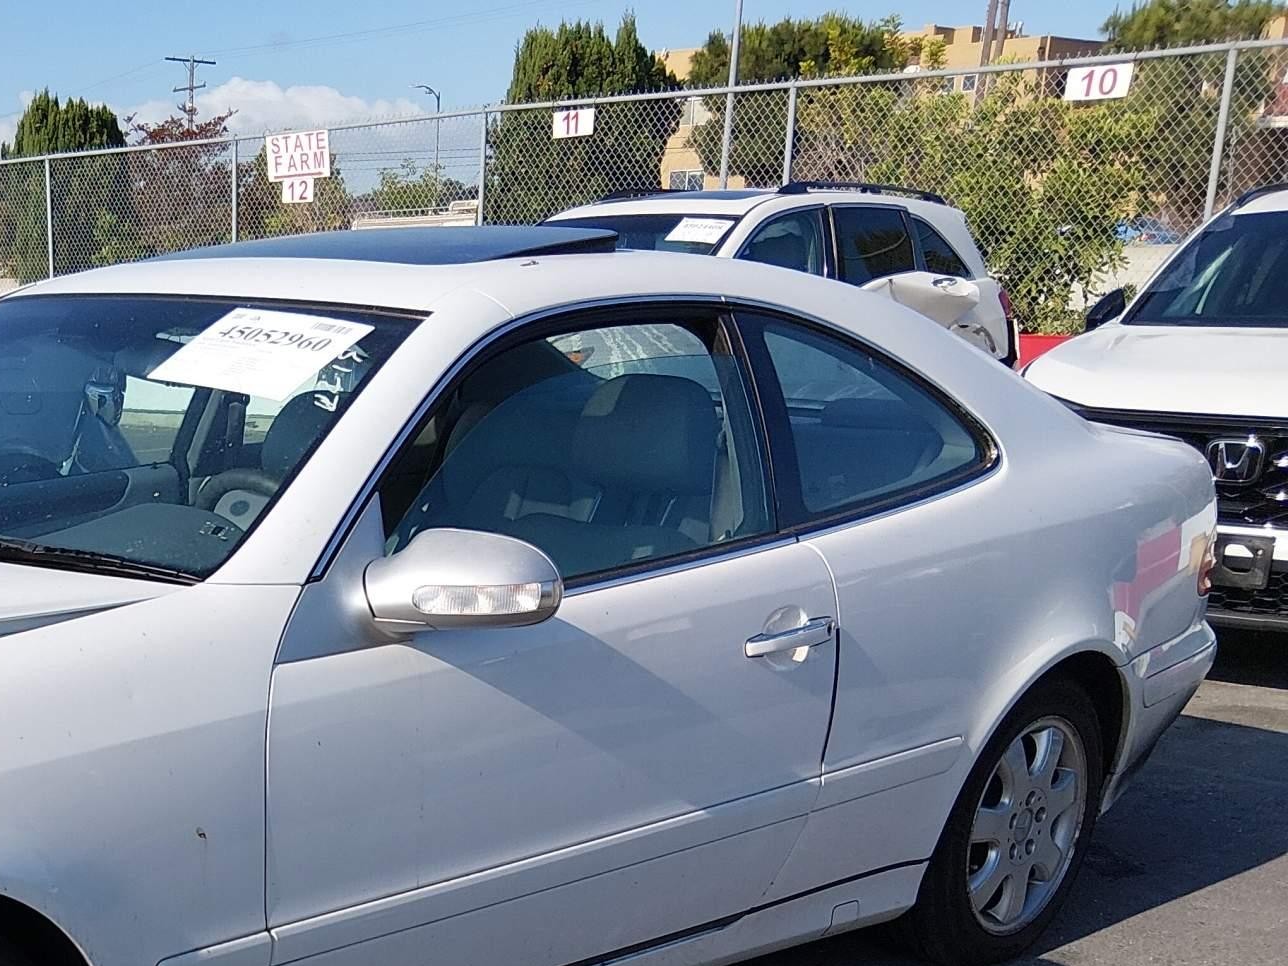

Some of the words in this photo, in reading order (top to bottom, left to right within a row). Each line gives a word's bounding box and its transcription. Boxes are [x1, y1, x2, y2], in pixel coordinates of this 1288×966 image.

[1081, 68, 1118, 97] 10
[562, 111, 579, 135] 11
[271, 131, 326, 155] STATE
[274, 150, 325, 173] FARM
[288, 180, 309, 201] 12
[218, 324, 333, 352] 45052960
